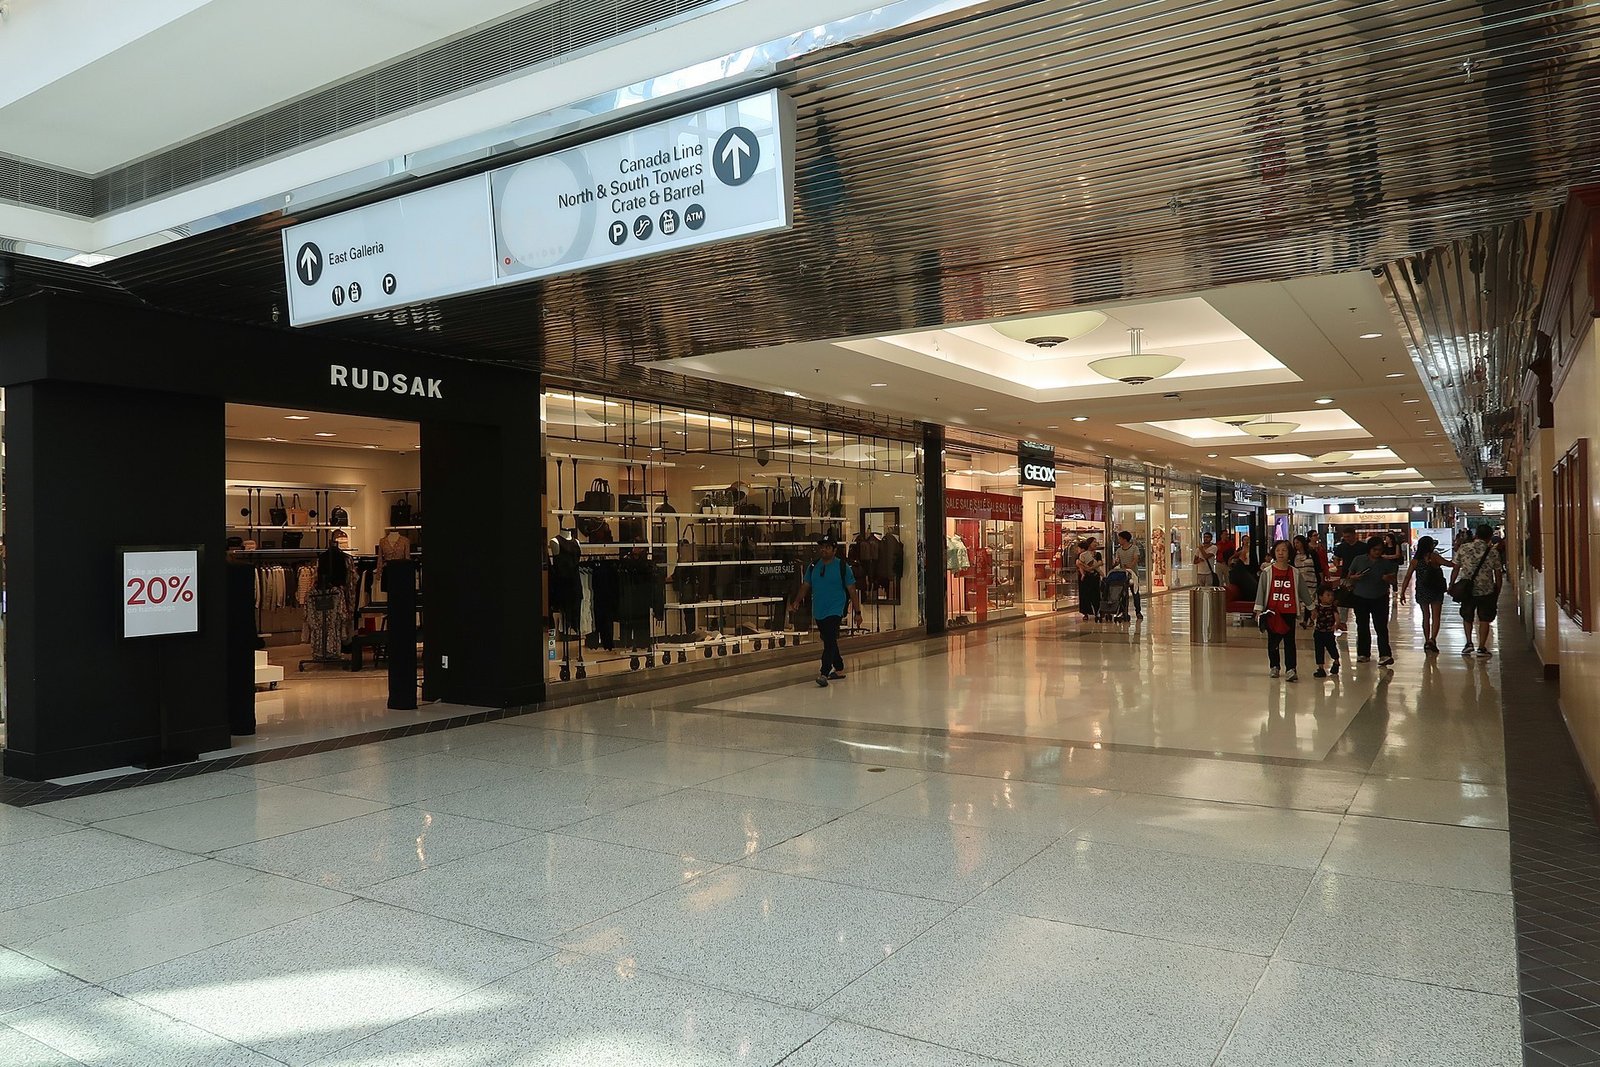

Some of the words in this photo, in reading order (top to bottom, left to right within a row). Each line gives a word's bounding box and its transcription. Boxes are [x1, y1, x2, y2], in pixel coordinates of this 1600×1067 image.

[620, 150, 670, 174] Canada
[673, 144, 703, 161] Line
[558, 188, 593, 208] North
[597, 184, 607, 199] &
[610, 173, 649, 196] South
[652, 163, 703, 185] Towers
[612, 196, 646, 214] Crate
[650, 190, 660, 205] &
[663, 179, 704, 202] Barrel
[686, 211, 703, 222] ATM
[329, 252, 348, 265] East
[349, 241, 384, 260] Galleria
[330, 364, 443, 399] RUDSAK
[1024, 463, 1056, 482] GEOX
[945, 497, 960, 509] SALE
[960, 498, 973, 511] SALE
[759, 565, 782, 575] SUMMER
[782, 564, 795, 573] SALE
[127, 575, 194, 605] 20%
[1274, 580, 1291, 588] BIG
[1272, 593, 1290, 602] BIG
